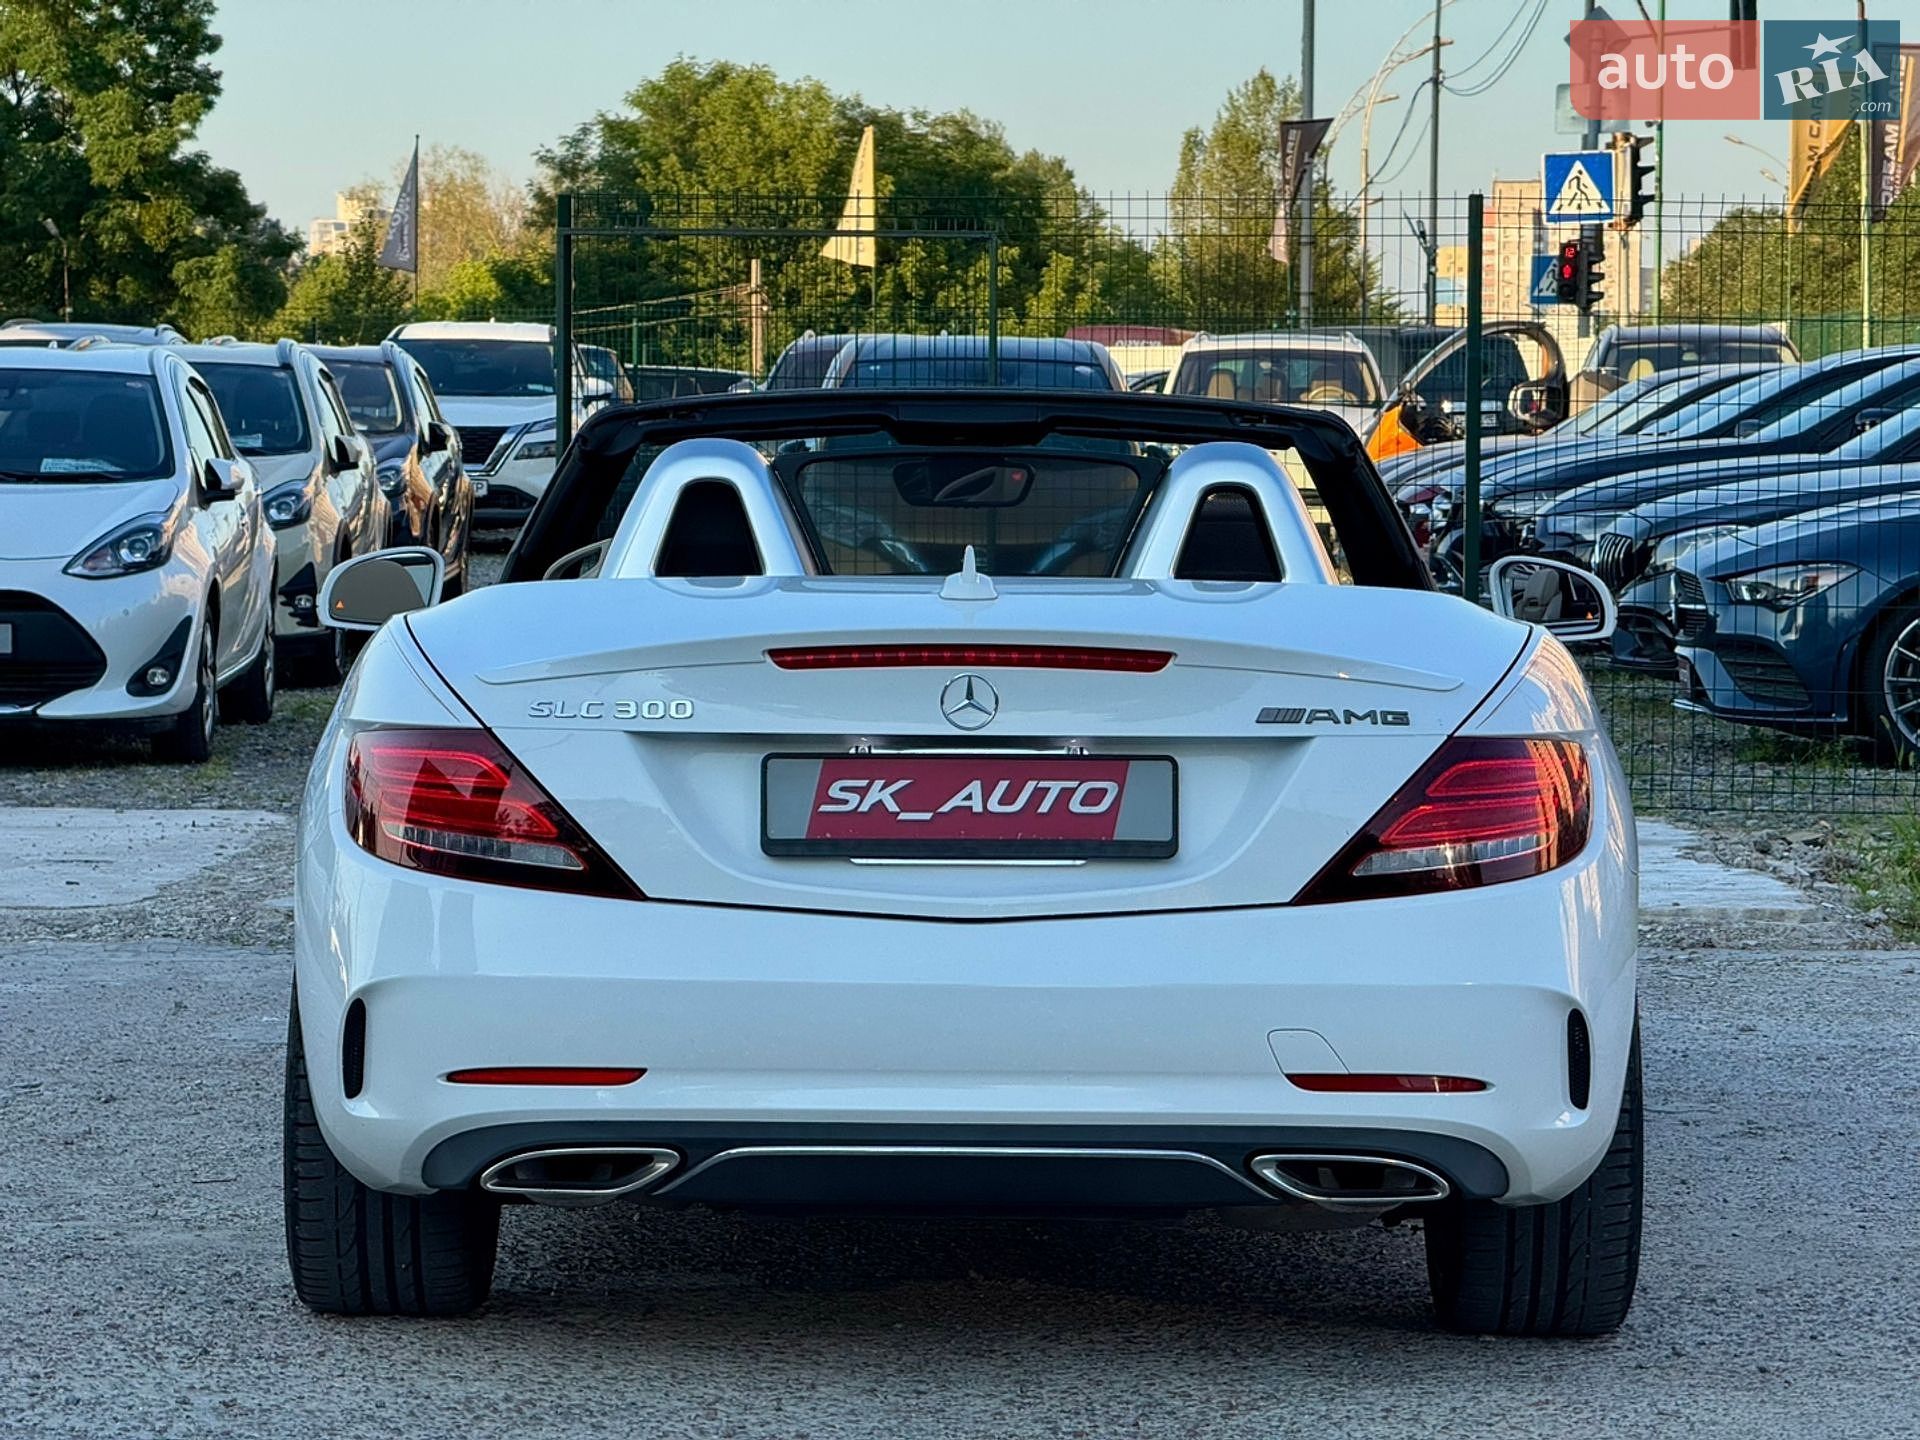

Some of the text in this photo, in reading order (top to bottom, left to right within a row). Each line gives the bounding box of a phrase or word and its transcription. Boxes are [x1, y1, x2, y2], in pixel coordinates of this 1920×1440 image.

[1880, 123, 1900, 212] DREAM
[528, 699, 695, 720] SLC 300
[1304, 708, 1411, 727] AMG
